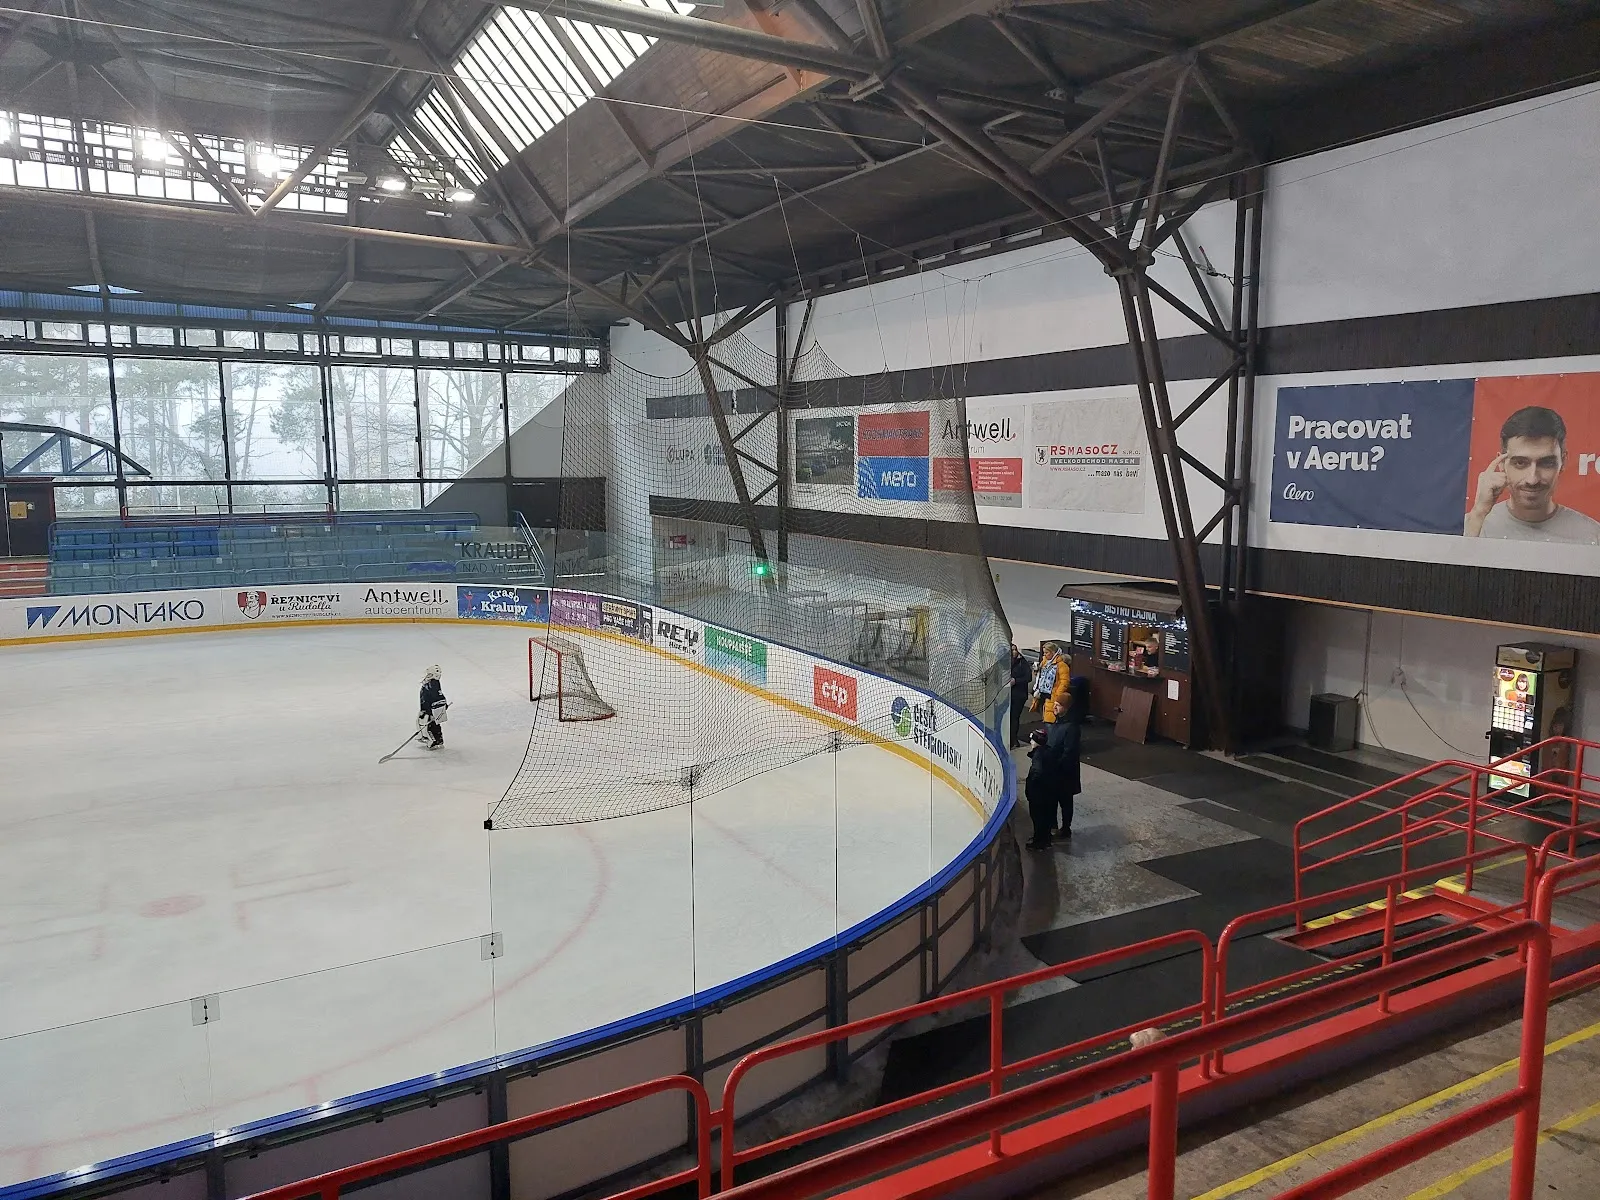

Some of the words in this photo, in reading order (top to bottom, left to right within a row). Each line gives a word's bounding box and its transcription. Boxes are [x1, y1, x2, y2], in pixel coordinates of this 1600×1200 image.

[1288, 414, 1412, 439] Pracovat
[1286, 452, 1301, 469] v
[1303, 445, 1385, 471] Aeru?
[1579, 453, 1600, 475] r
[487, 589, 520, 603] Kraso
[57, 599, 205, 628] MONTAKO
[287, 601, 332, 613] Rudolfa
[365, 605, 442, 615] autocentrum
[480, 601, 528, 616] Kralupy
